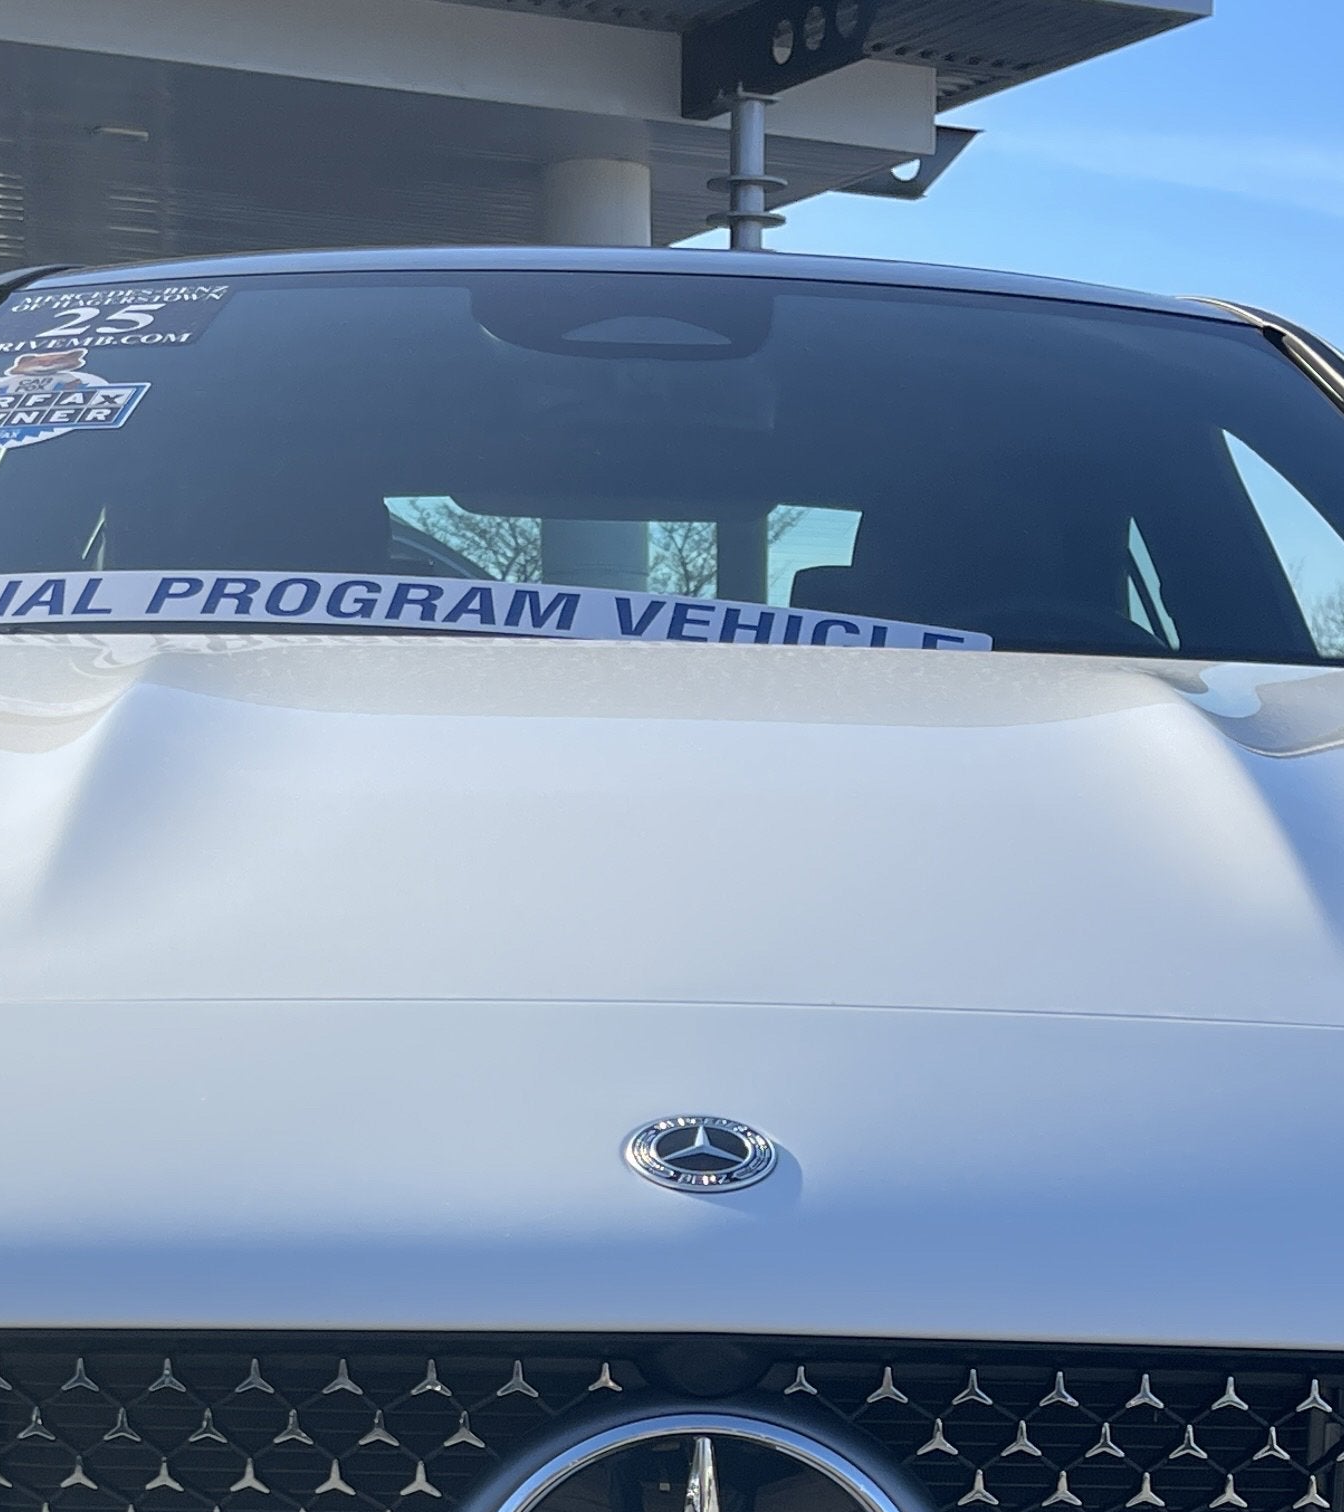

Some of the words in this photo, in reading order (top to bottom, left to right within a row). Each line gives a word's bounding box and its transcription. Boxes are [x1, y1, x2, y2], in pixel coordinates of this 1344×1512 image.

[34, 303, 167, 338] 25
[14, 384, 47, 392] FOX
[18, 377, 53, 386] CAR
[146, 577, 581, 630] PROGRAM
